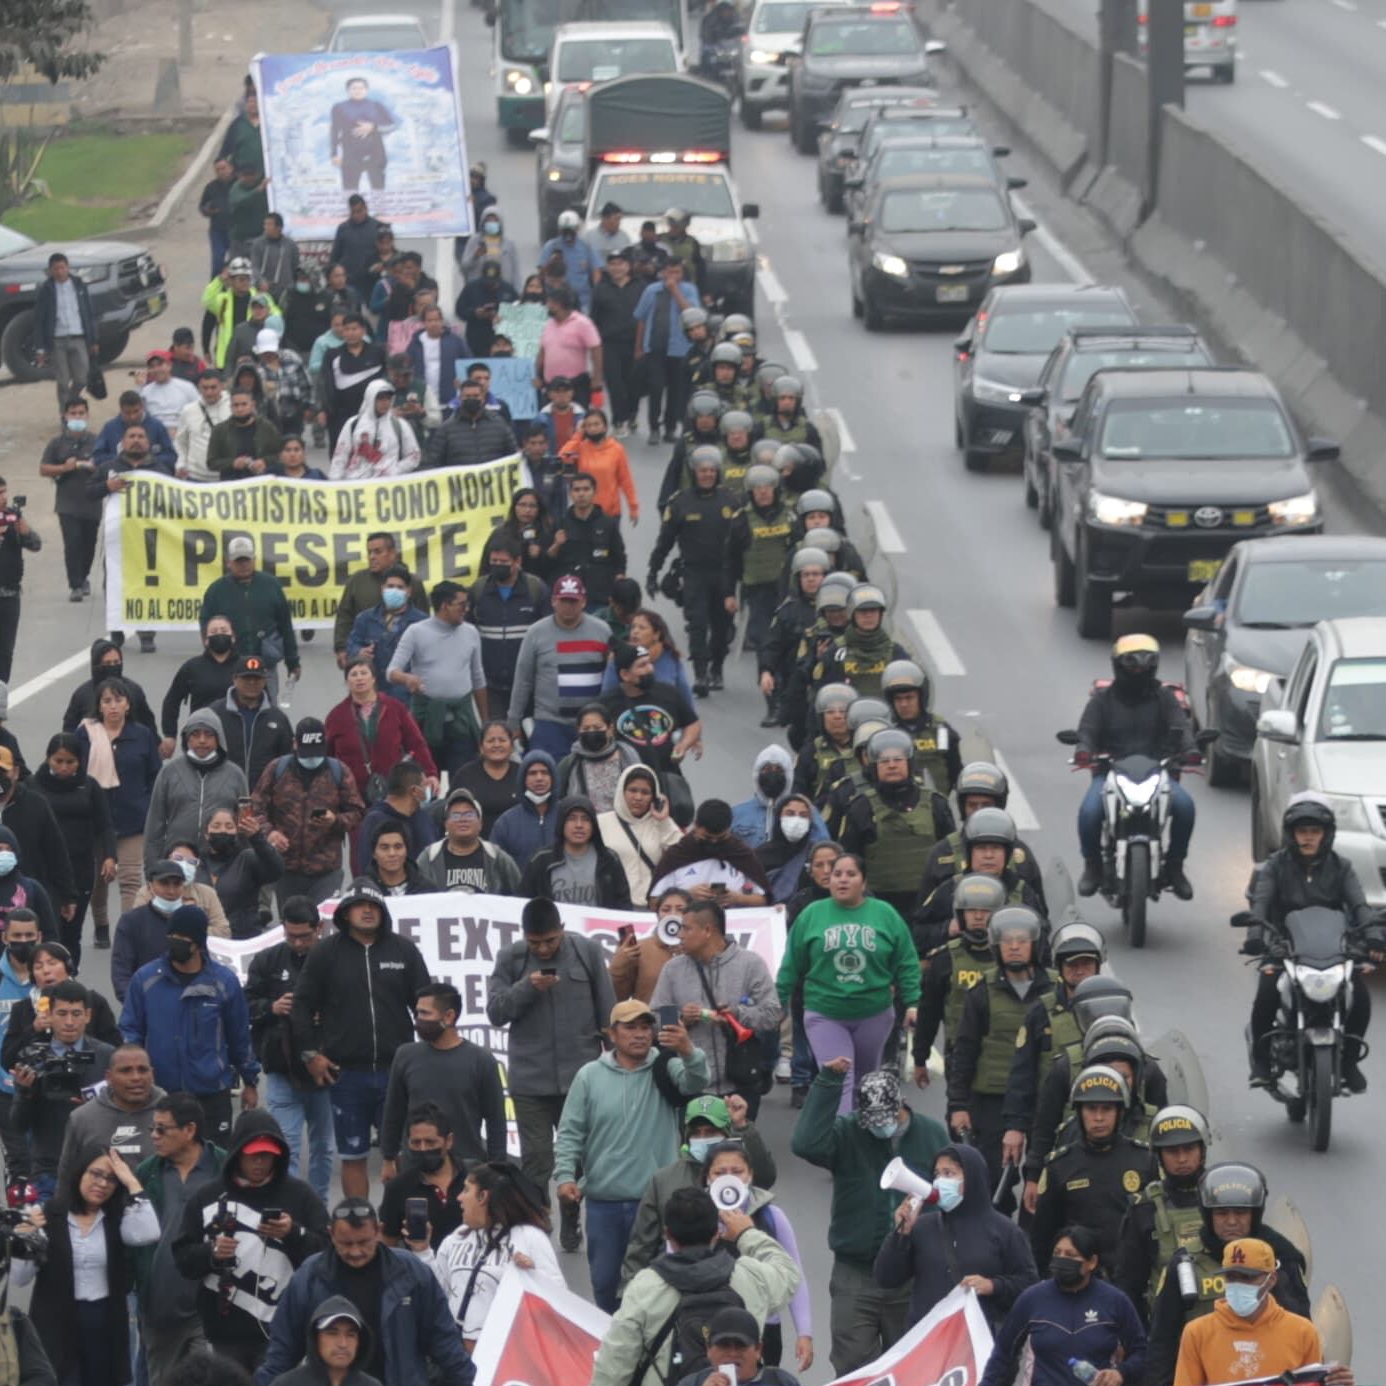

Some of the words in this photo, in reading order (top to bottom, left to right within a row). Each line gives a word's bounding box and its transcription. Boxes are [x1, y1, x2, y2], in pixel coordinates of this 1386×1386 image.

[124, 479, 330, 525] TRANSPORTISTAS
[337, 488, 366, 524] DE
[376, 474, 440, 523] CONO
[449, 462, 521, 513] NORTE
[125, 599, 146, 621] NO
[149, 599, 166, 620] AL
[301, 732, 323, 744] UFC
[824, 924, 876, 952] NYC
[1080, 1076, 1119, 1092] POLICIA
[115, 1125, 138, 1137] NIKE
[1159, 1118, 1192, 1135] POLICIA
